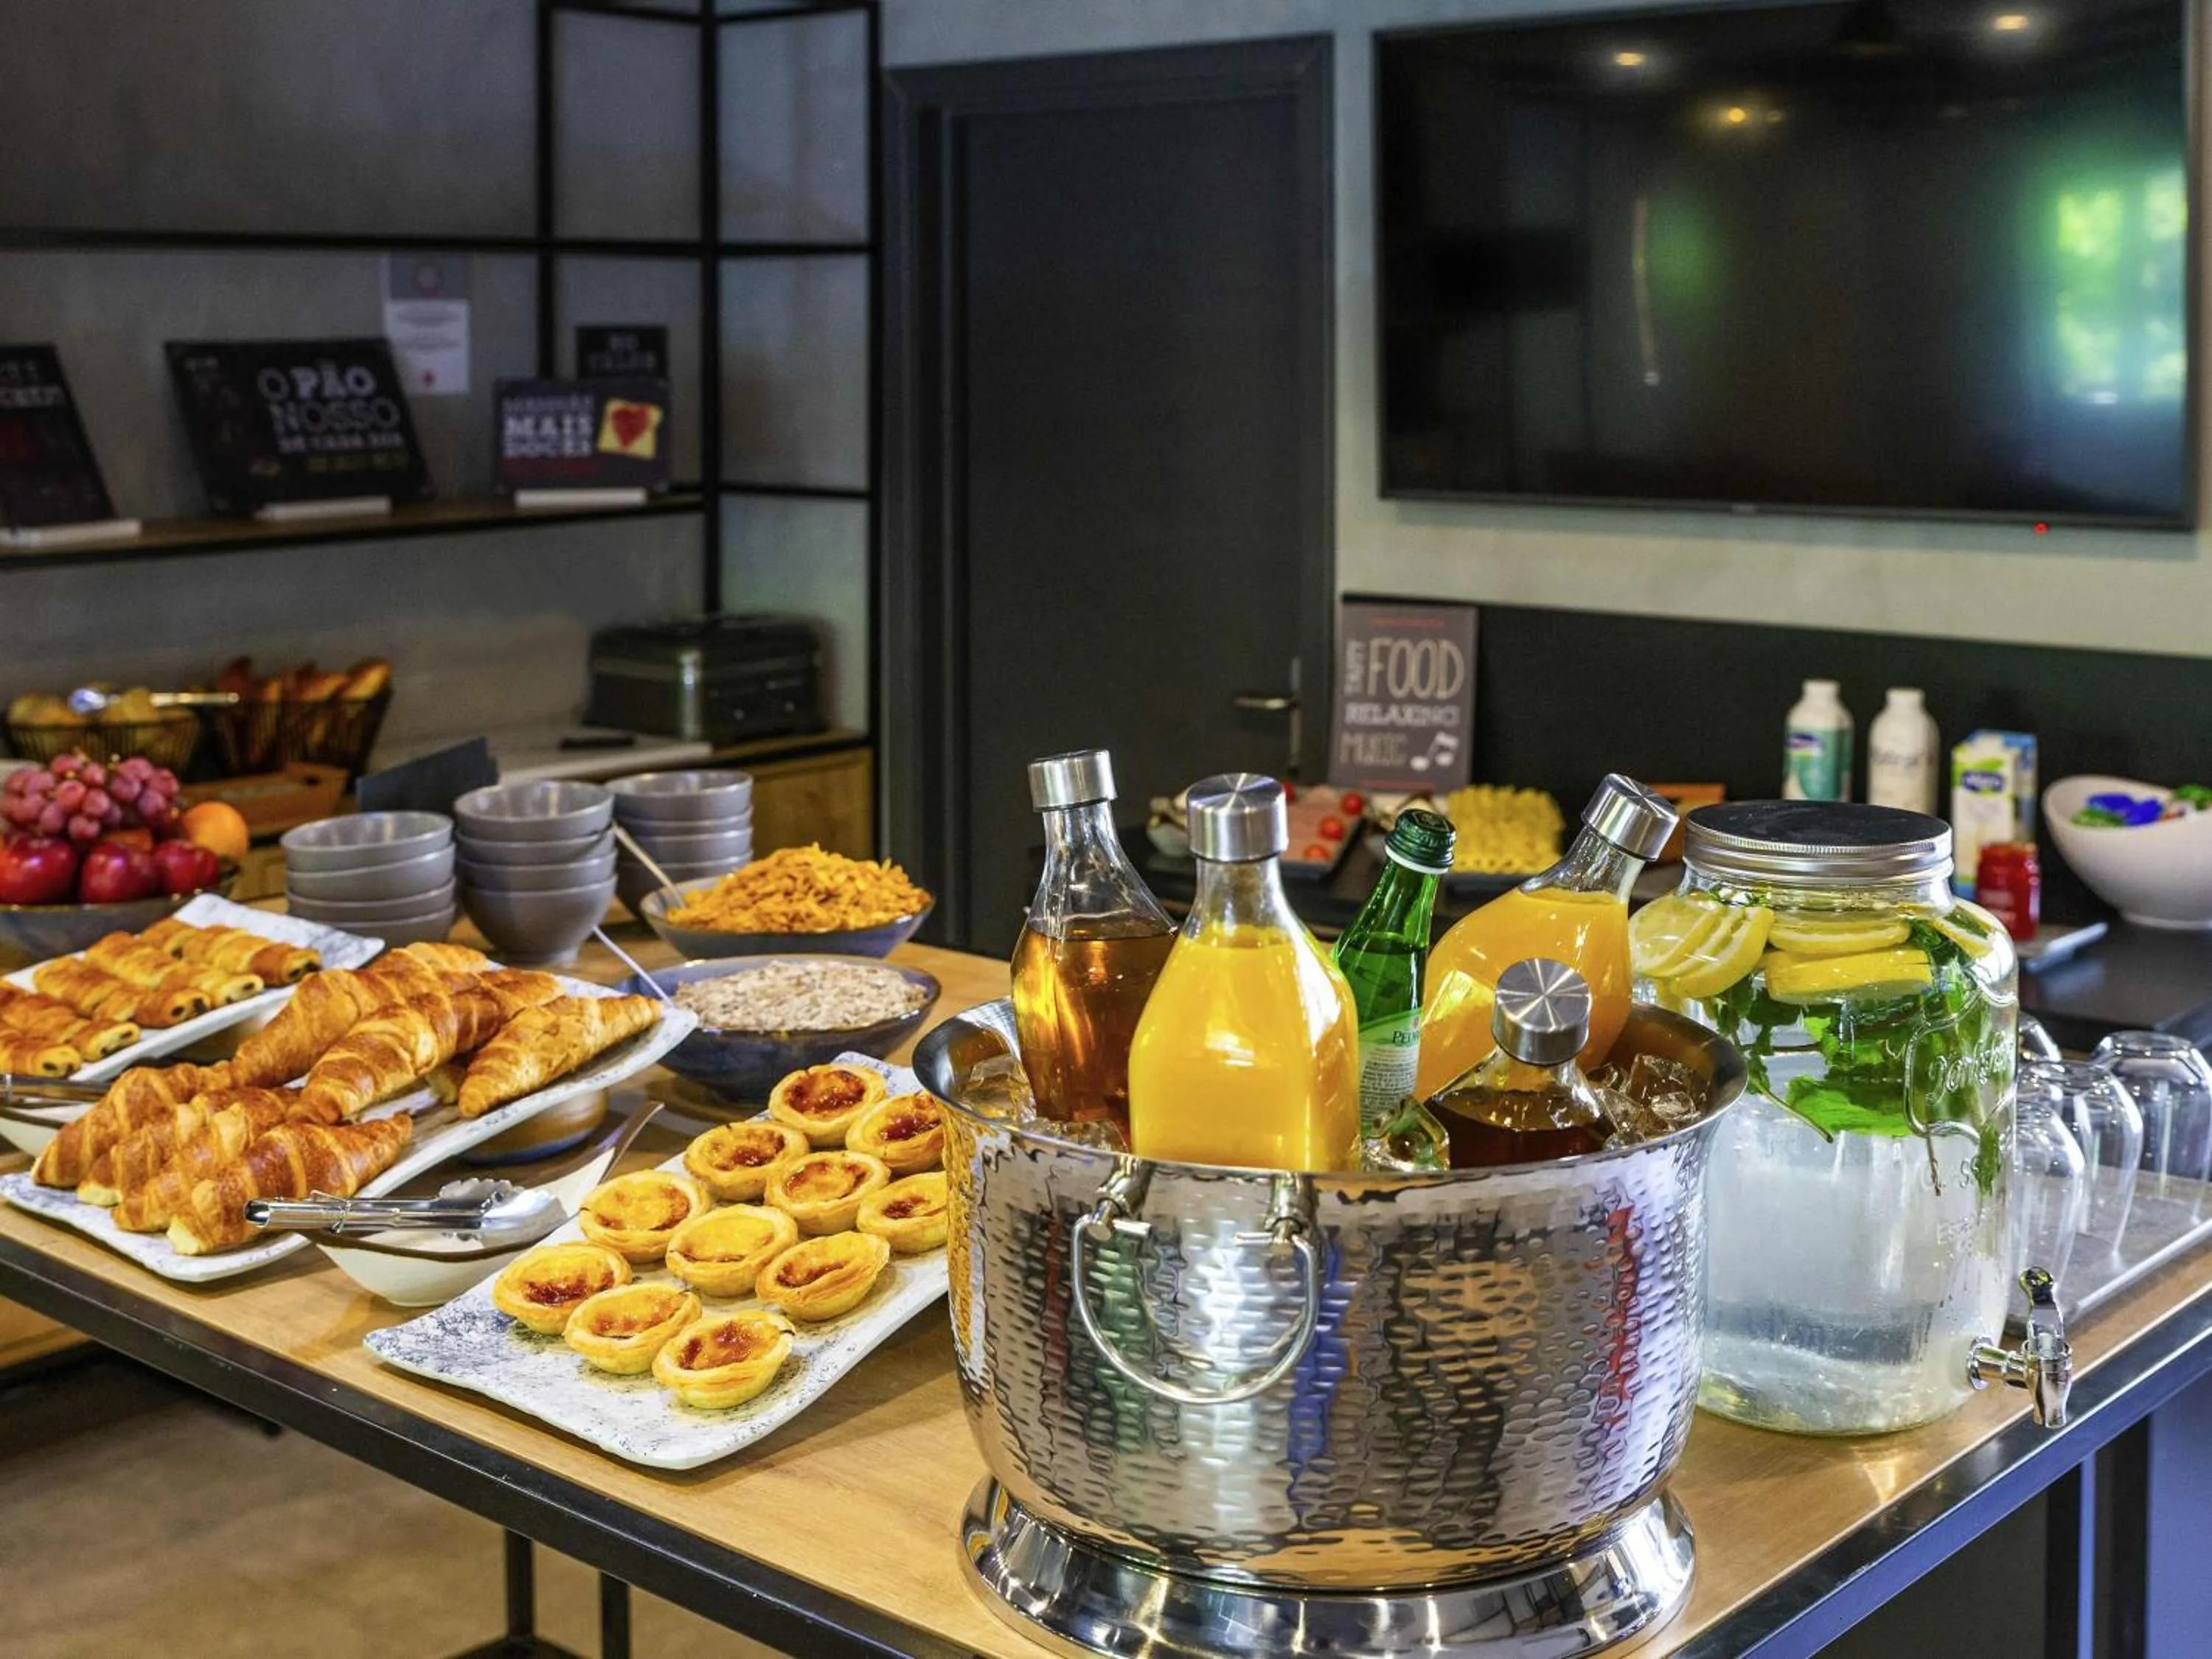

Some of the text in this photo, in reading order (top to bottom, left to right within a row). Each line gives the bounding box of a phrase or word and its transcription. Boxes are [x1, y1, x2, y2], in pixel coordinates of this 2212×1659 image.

[258, 358, 376, 401] O PÃO
[268, 397, 400, 434] NOSSO
[1367, 637, 1465, 699] FOOD
